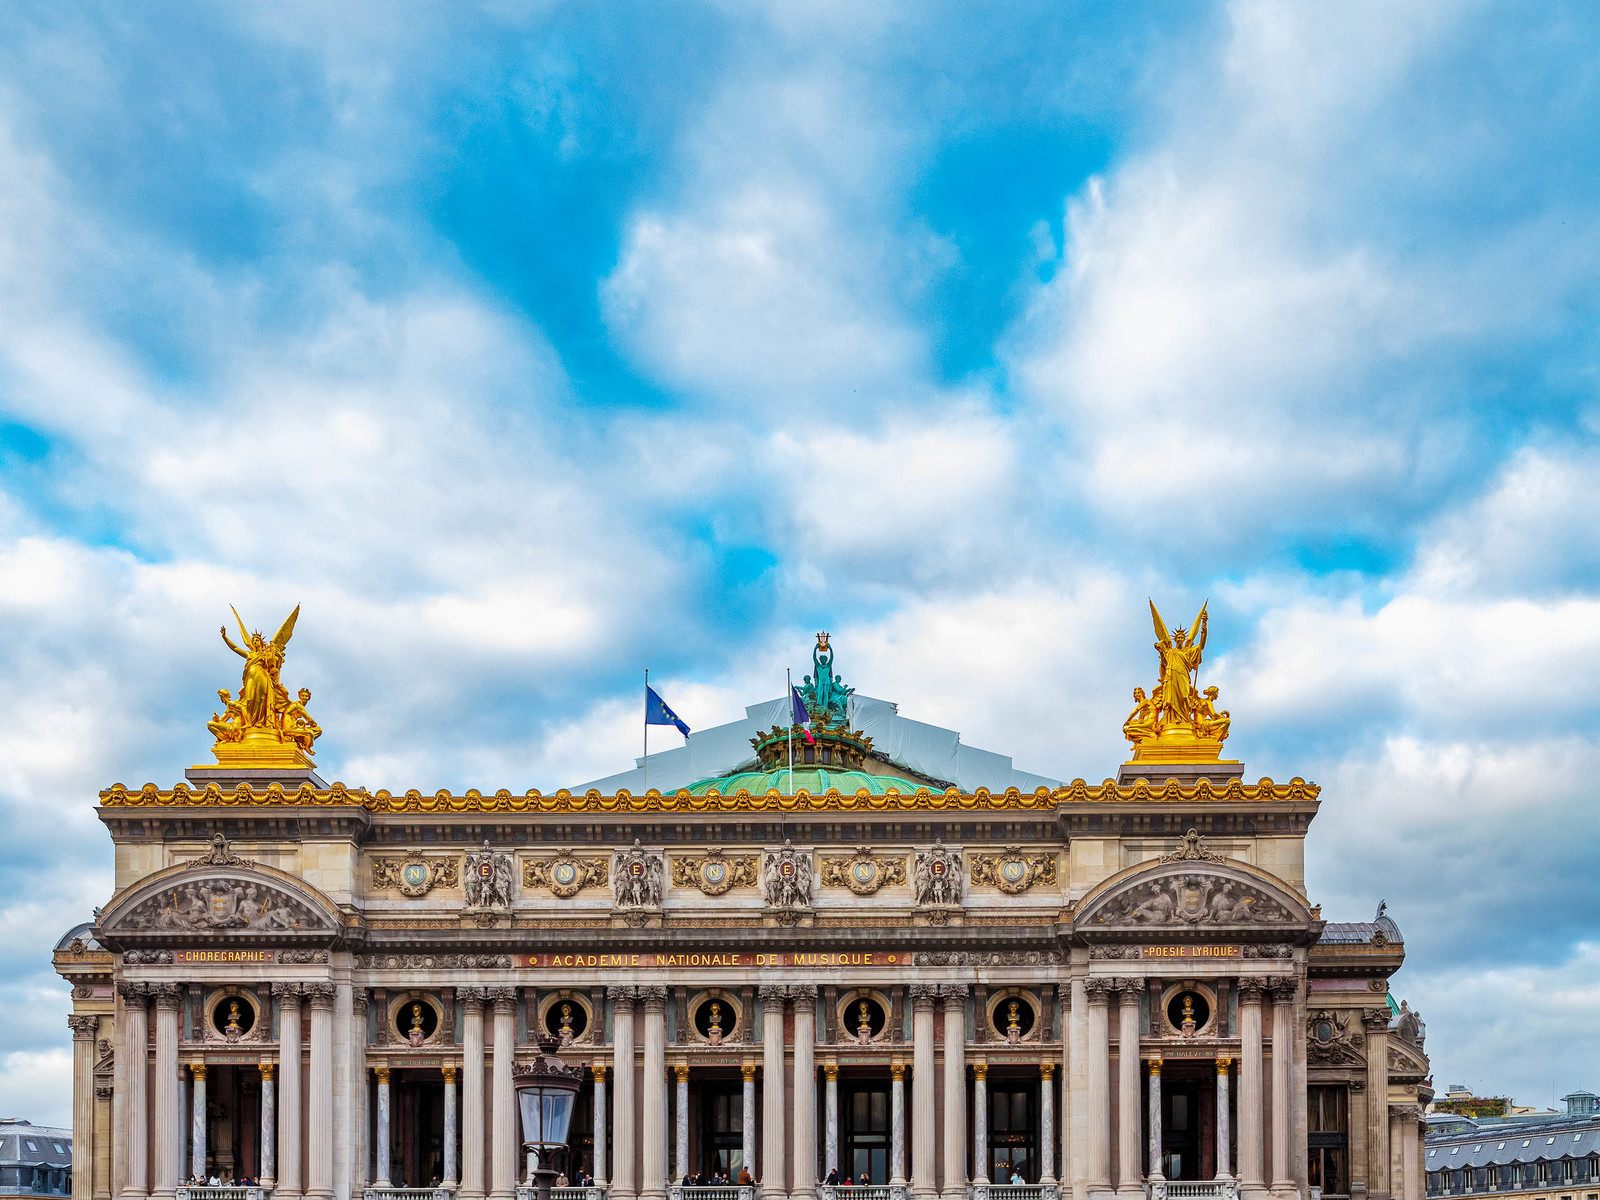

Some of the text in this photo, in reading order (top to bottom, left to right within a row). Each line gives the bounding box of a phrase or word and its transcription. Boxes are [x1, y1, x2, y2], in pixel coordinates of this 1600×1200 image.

[410, 869, 420, 878] N
[481, 866, 489, 876] E
[560, 868, 570, 878] N
[633, 865, 640, 875] E
[709, 867, 719, 878] N
[784, 865, 791, 875] E
[859, 866, 869, 877] N
[934, 864, 942, 874] E
[1008, 865, 1018, 875] N
[185, 951, 265, 961] CHOREGRAPHIE
[1149, 946, 1233, 957] POESIE LYRIQUE
[552, 953, 873, 967] ACADEMIE NATIONALE DE MUSIQUE
